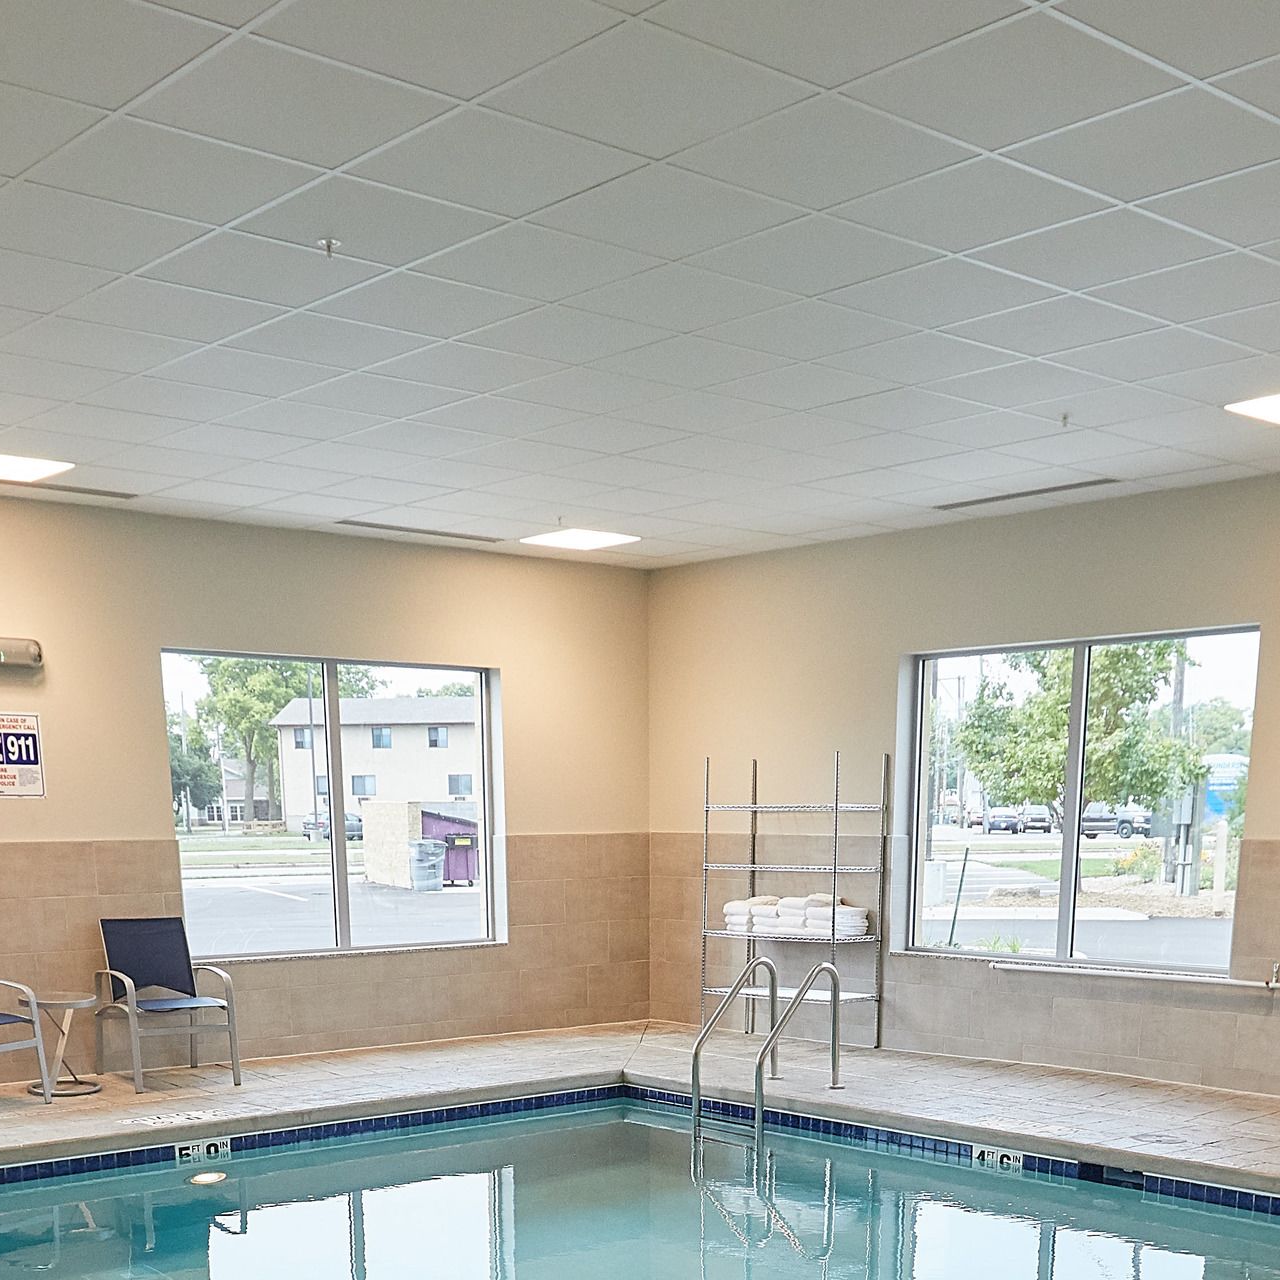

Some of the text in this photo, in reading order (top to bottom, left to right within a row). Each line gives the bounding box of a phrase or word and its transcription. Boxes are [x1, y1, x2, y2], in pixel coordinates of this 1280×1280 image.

[6, 735, 35, 761] 911
[179, 1146, 191, 1159] 5
[987, 1151, 995, 1159] FT
[1012, 1155, 1021, 1164] IN
